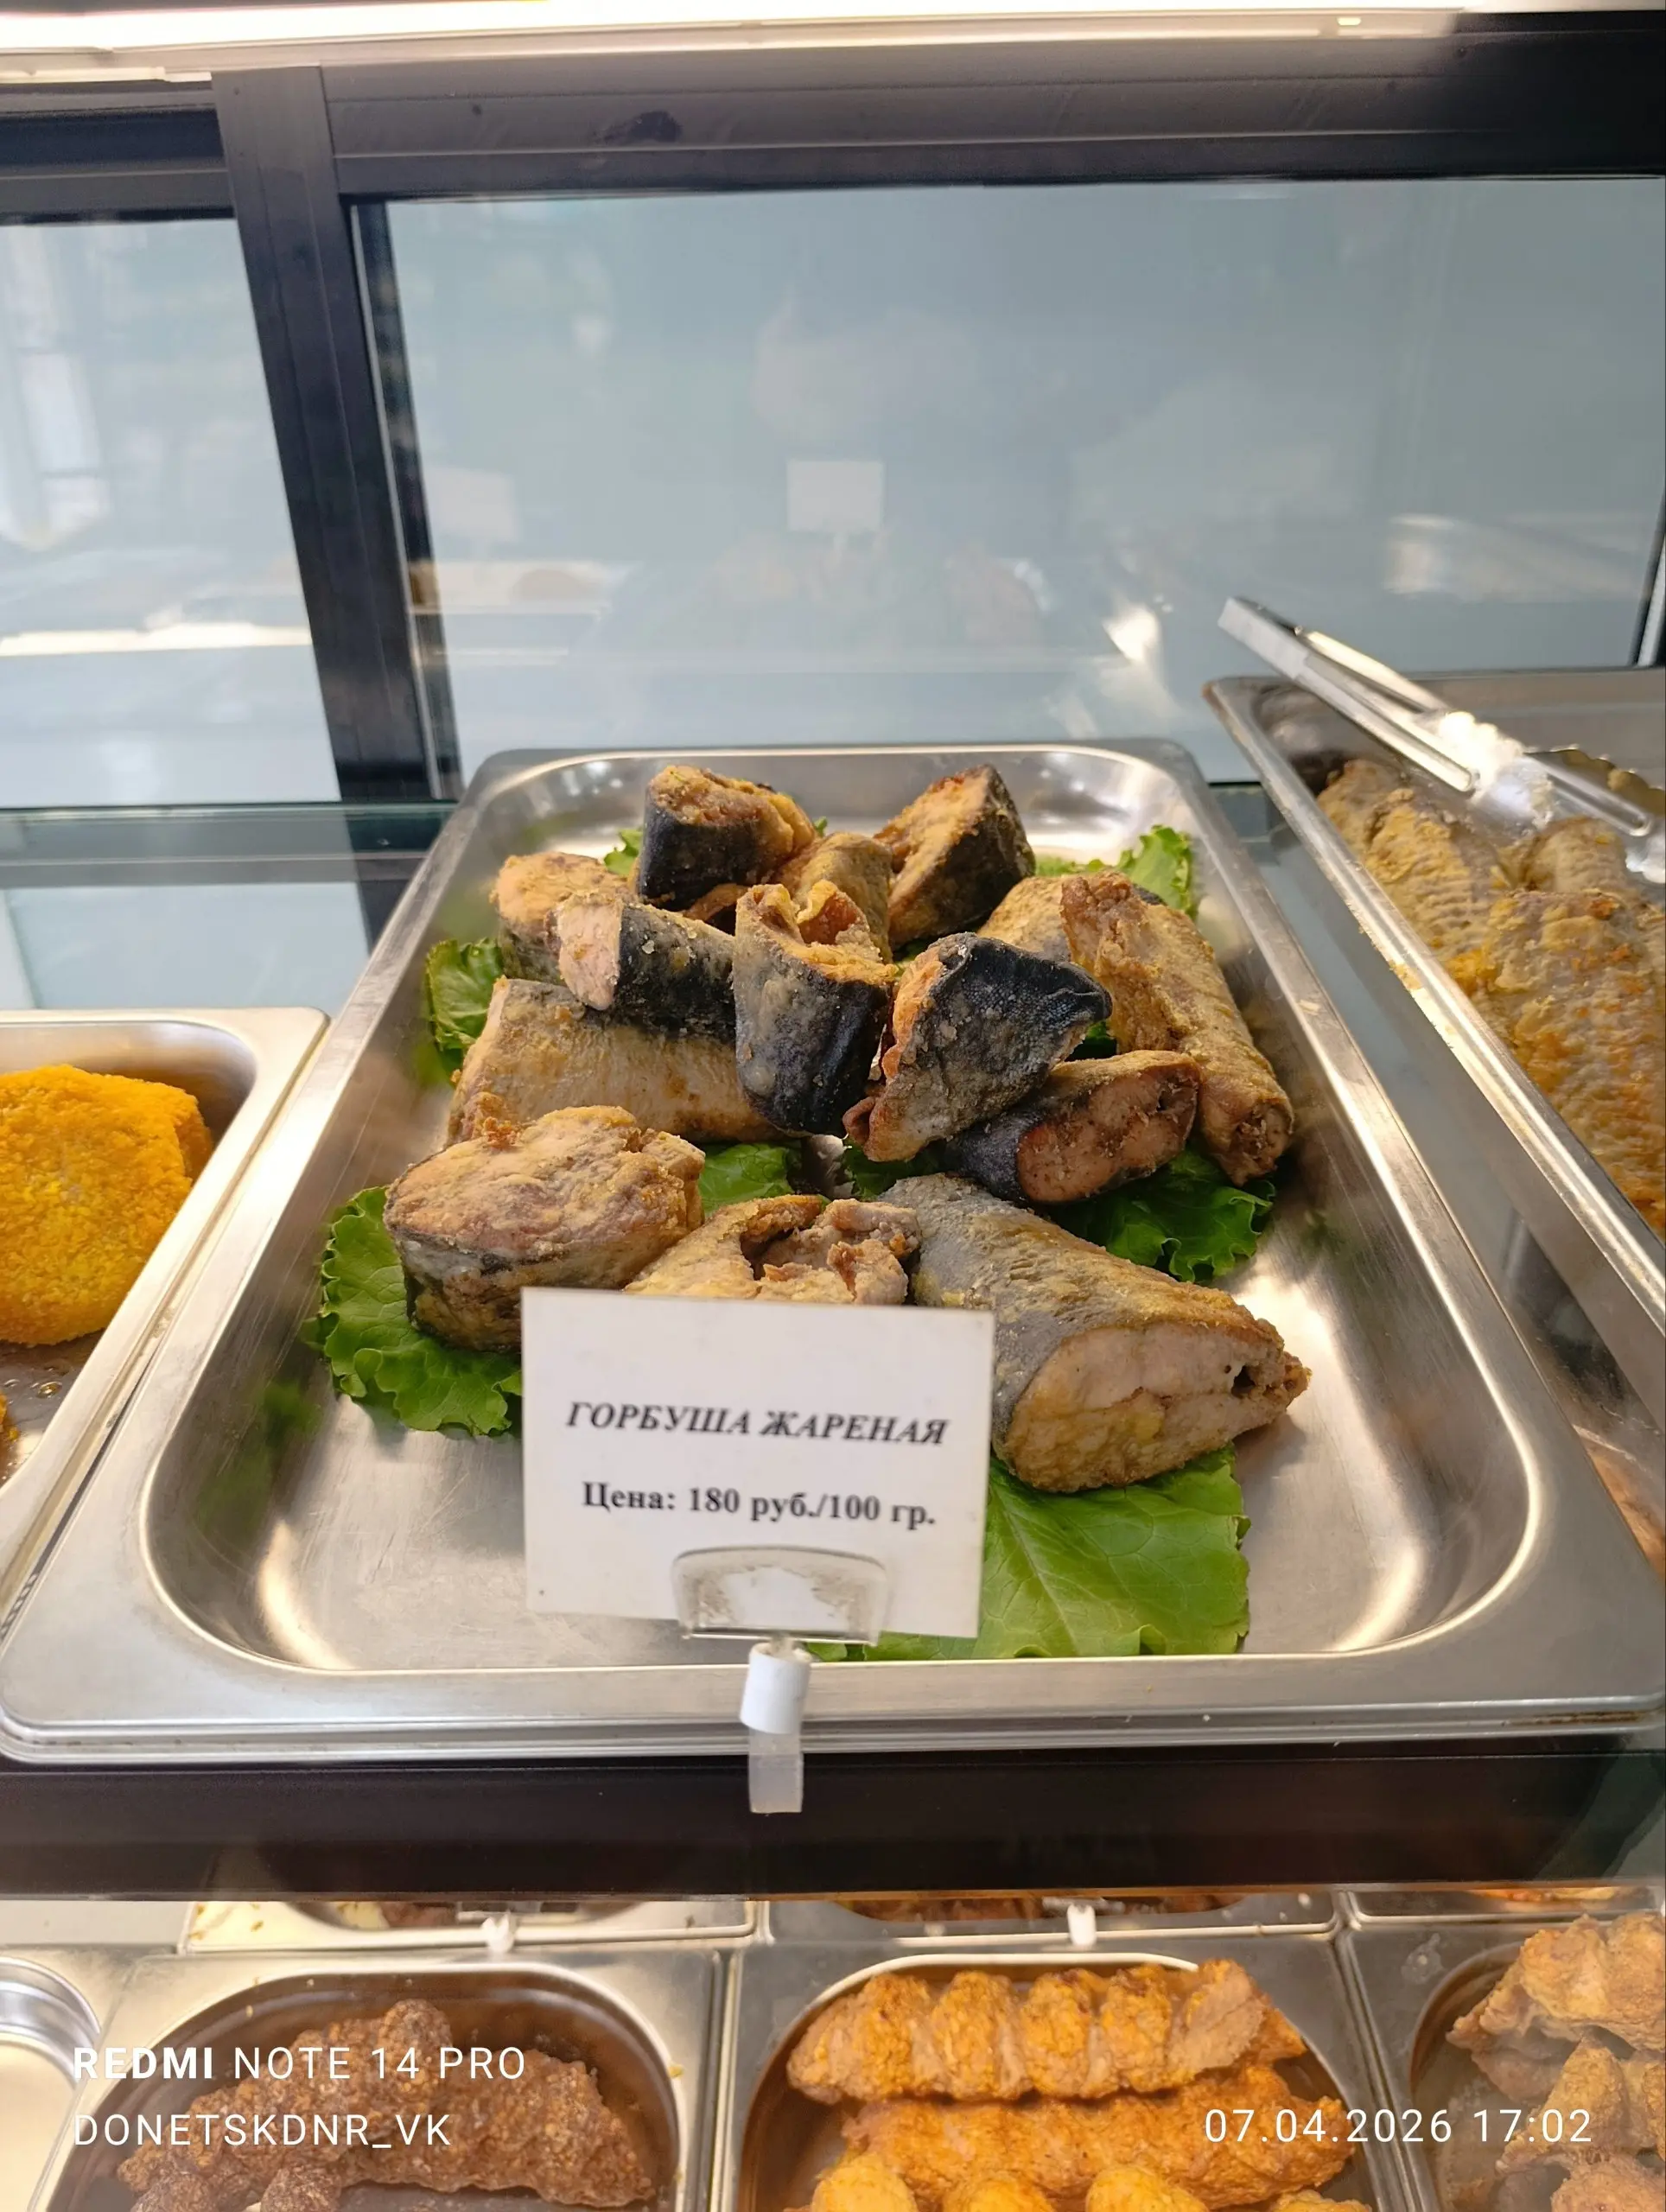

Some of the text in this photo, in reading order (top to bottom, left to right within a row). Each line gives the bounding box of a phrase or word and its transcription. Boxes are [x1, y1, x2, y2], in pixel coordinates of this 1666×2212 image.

[566, 1402, 951, 1446] ГОРБУША ЖАРЕНАЯ
[582, 1482, 935, 1530] Цена: 180 руб./100 гр.
